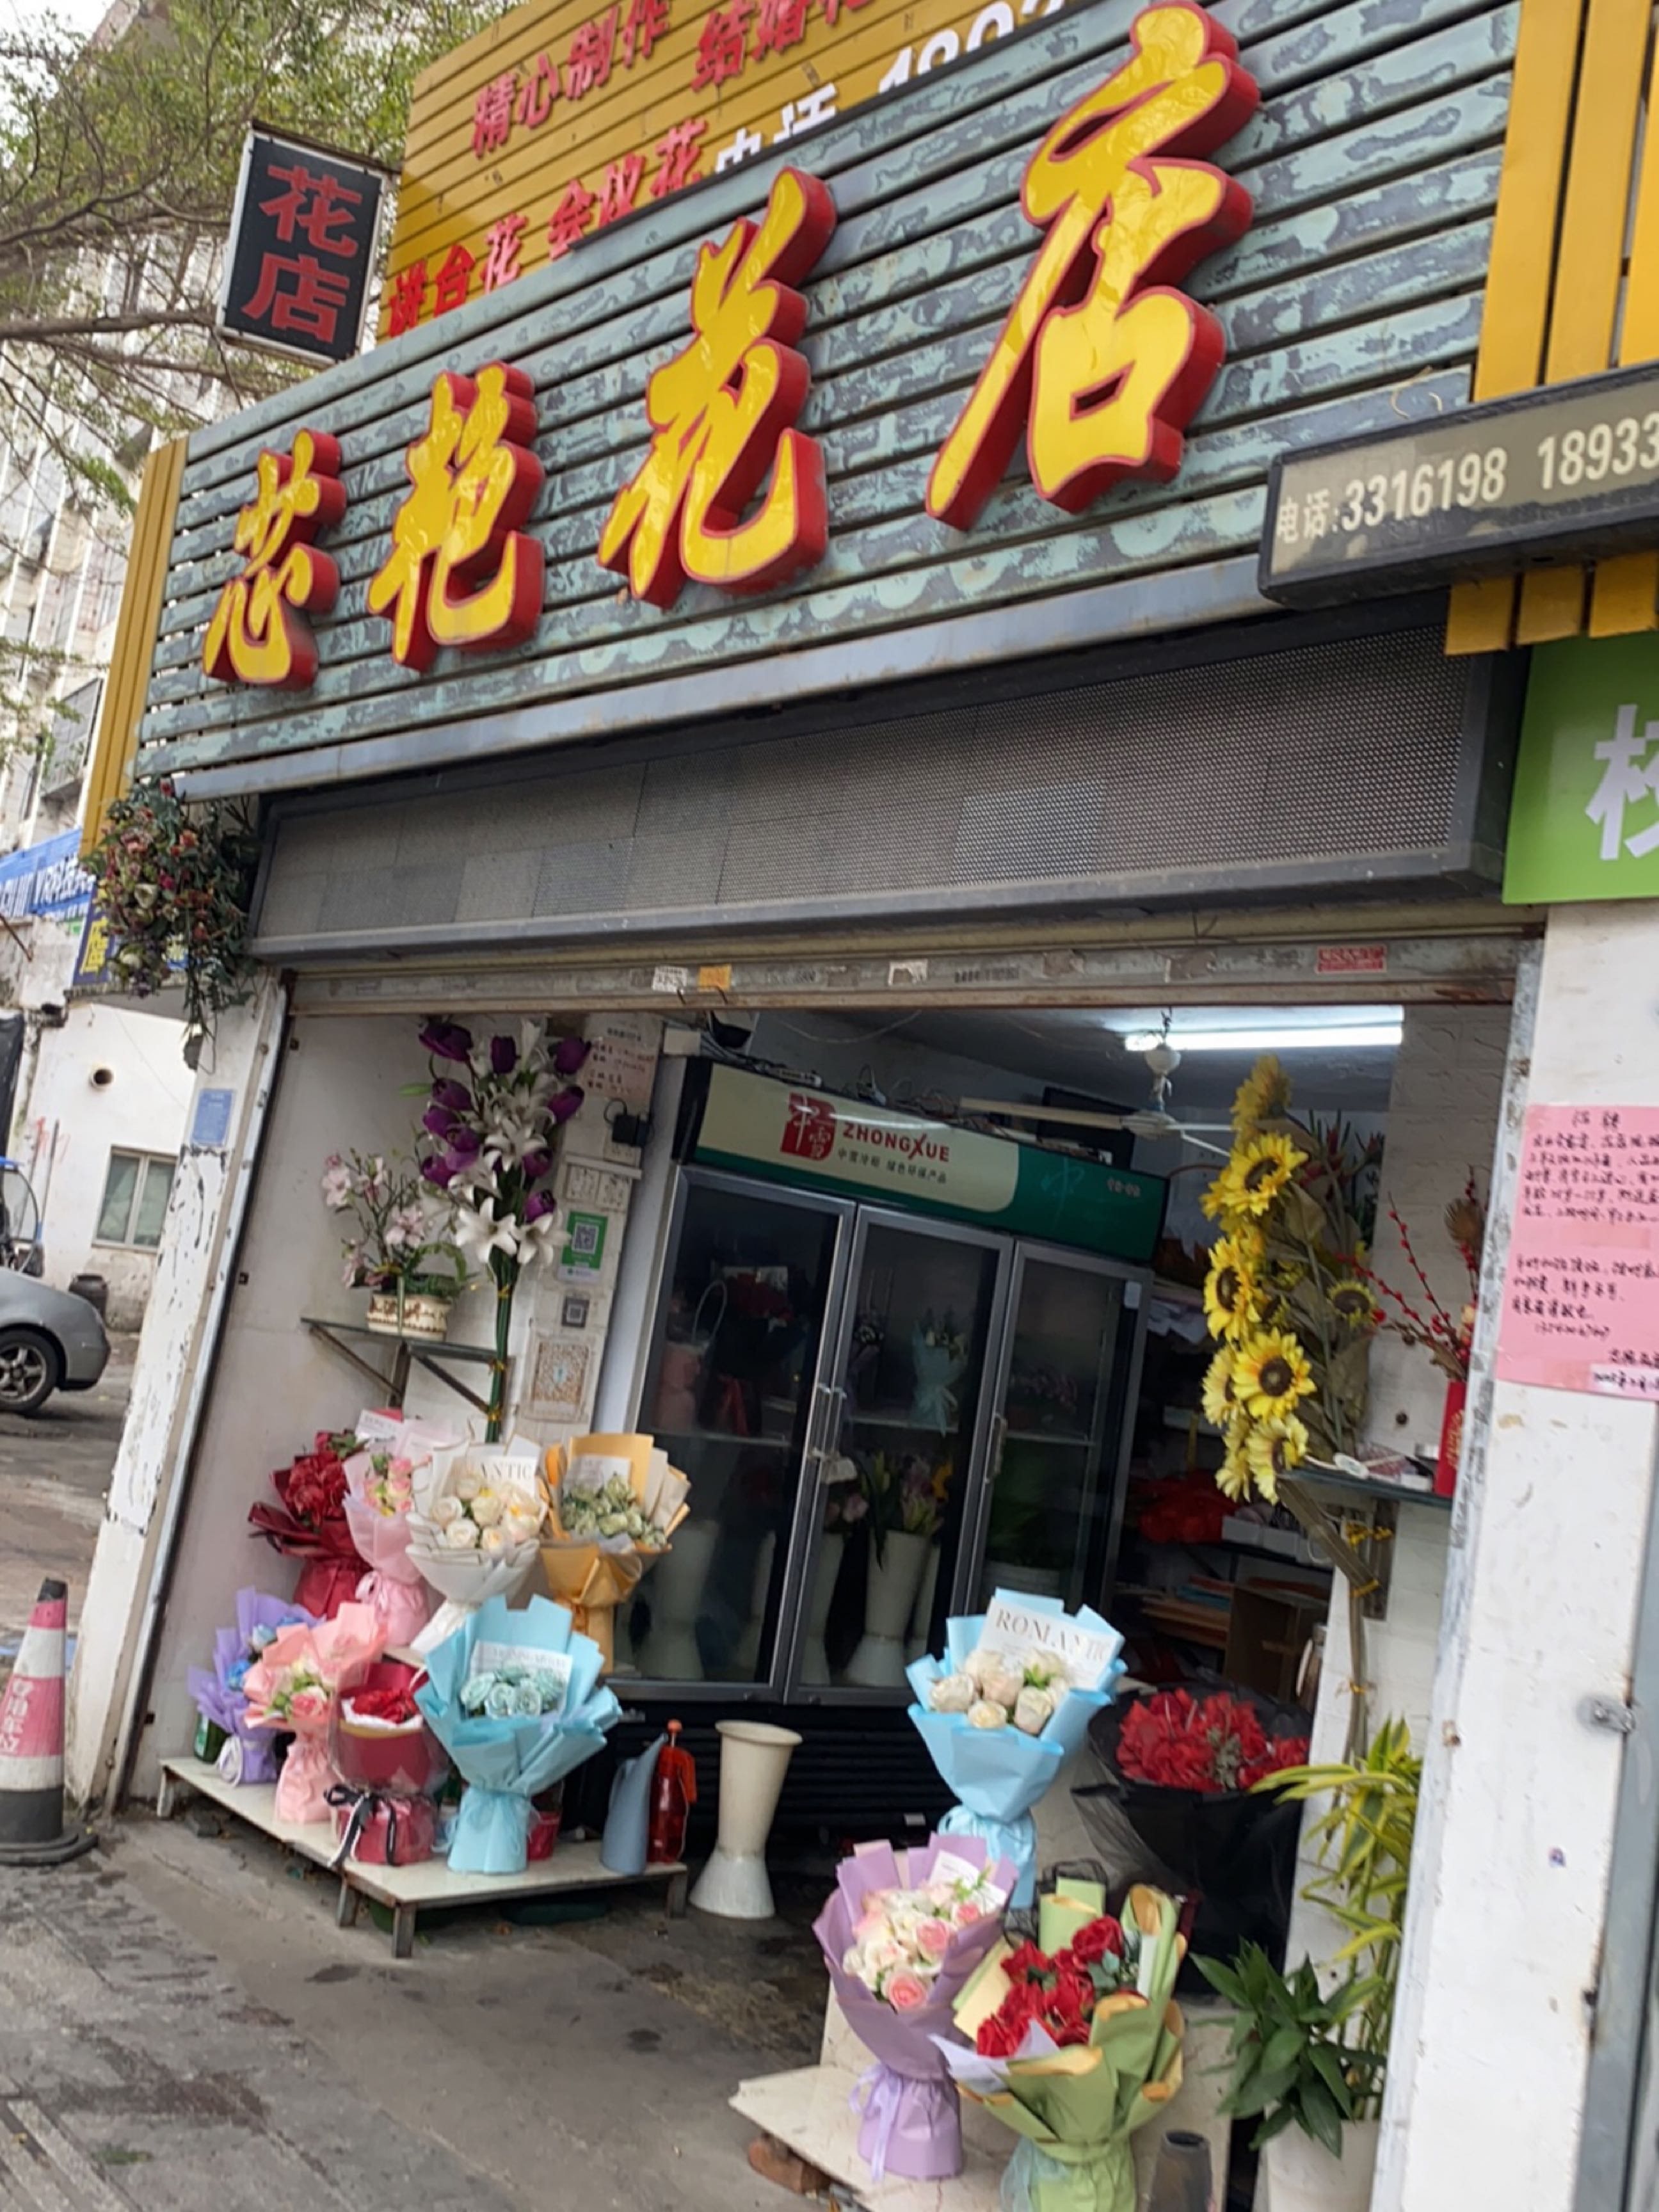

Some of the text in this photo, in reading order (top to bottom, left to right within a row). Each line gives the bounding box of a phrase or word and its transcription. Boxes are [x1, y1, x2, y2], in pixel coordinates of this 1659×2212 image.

[472, 0, 670, 158] 精心制作
[242, 164, 363, 343] 花店
[1537, 411, 1659, 490] 18933
[842, 1121, 950, 1162] ZHONGXUE
